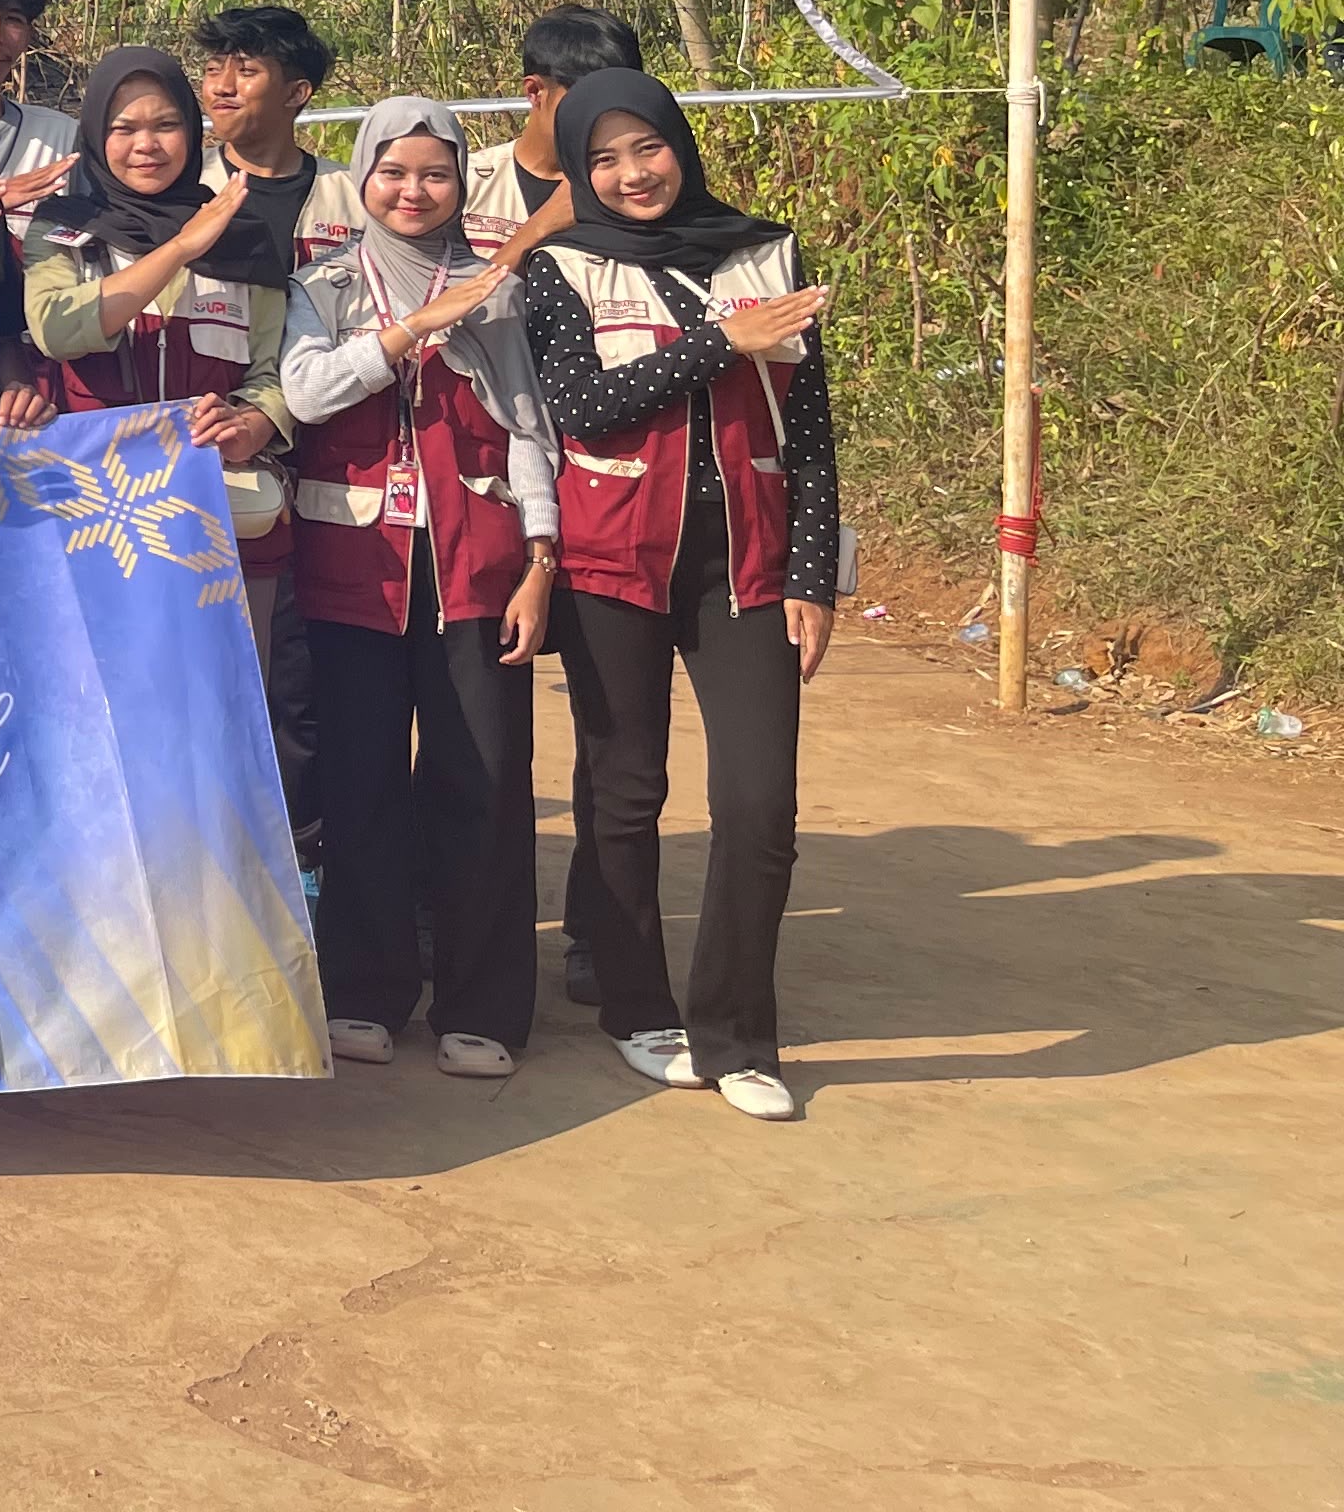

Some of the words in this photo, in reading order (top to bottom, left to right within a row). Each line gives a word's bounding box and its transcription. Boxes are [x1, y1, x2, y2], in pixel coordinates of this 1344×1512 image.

[327, 223, 348, 237] UPI
[206, 302, 227, 315] UPI
[731, 297, 759, 310] UPI
